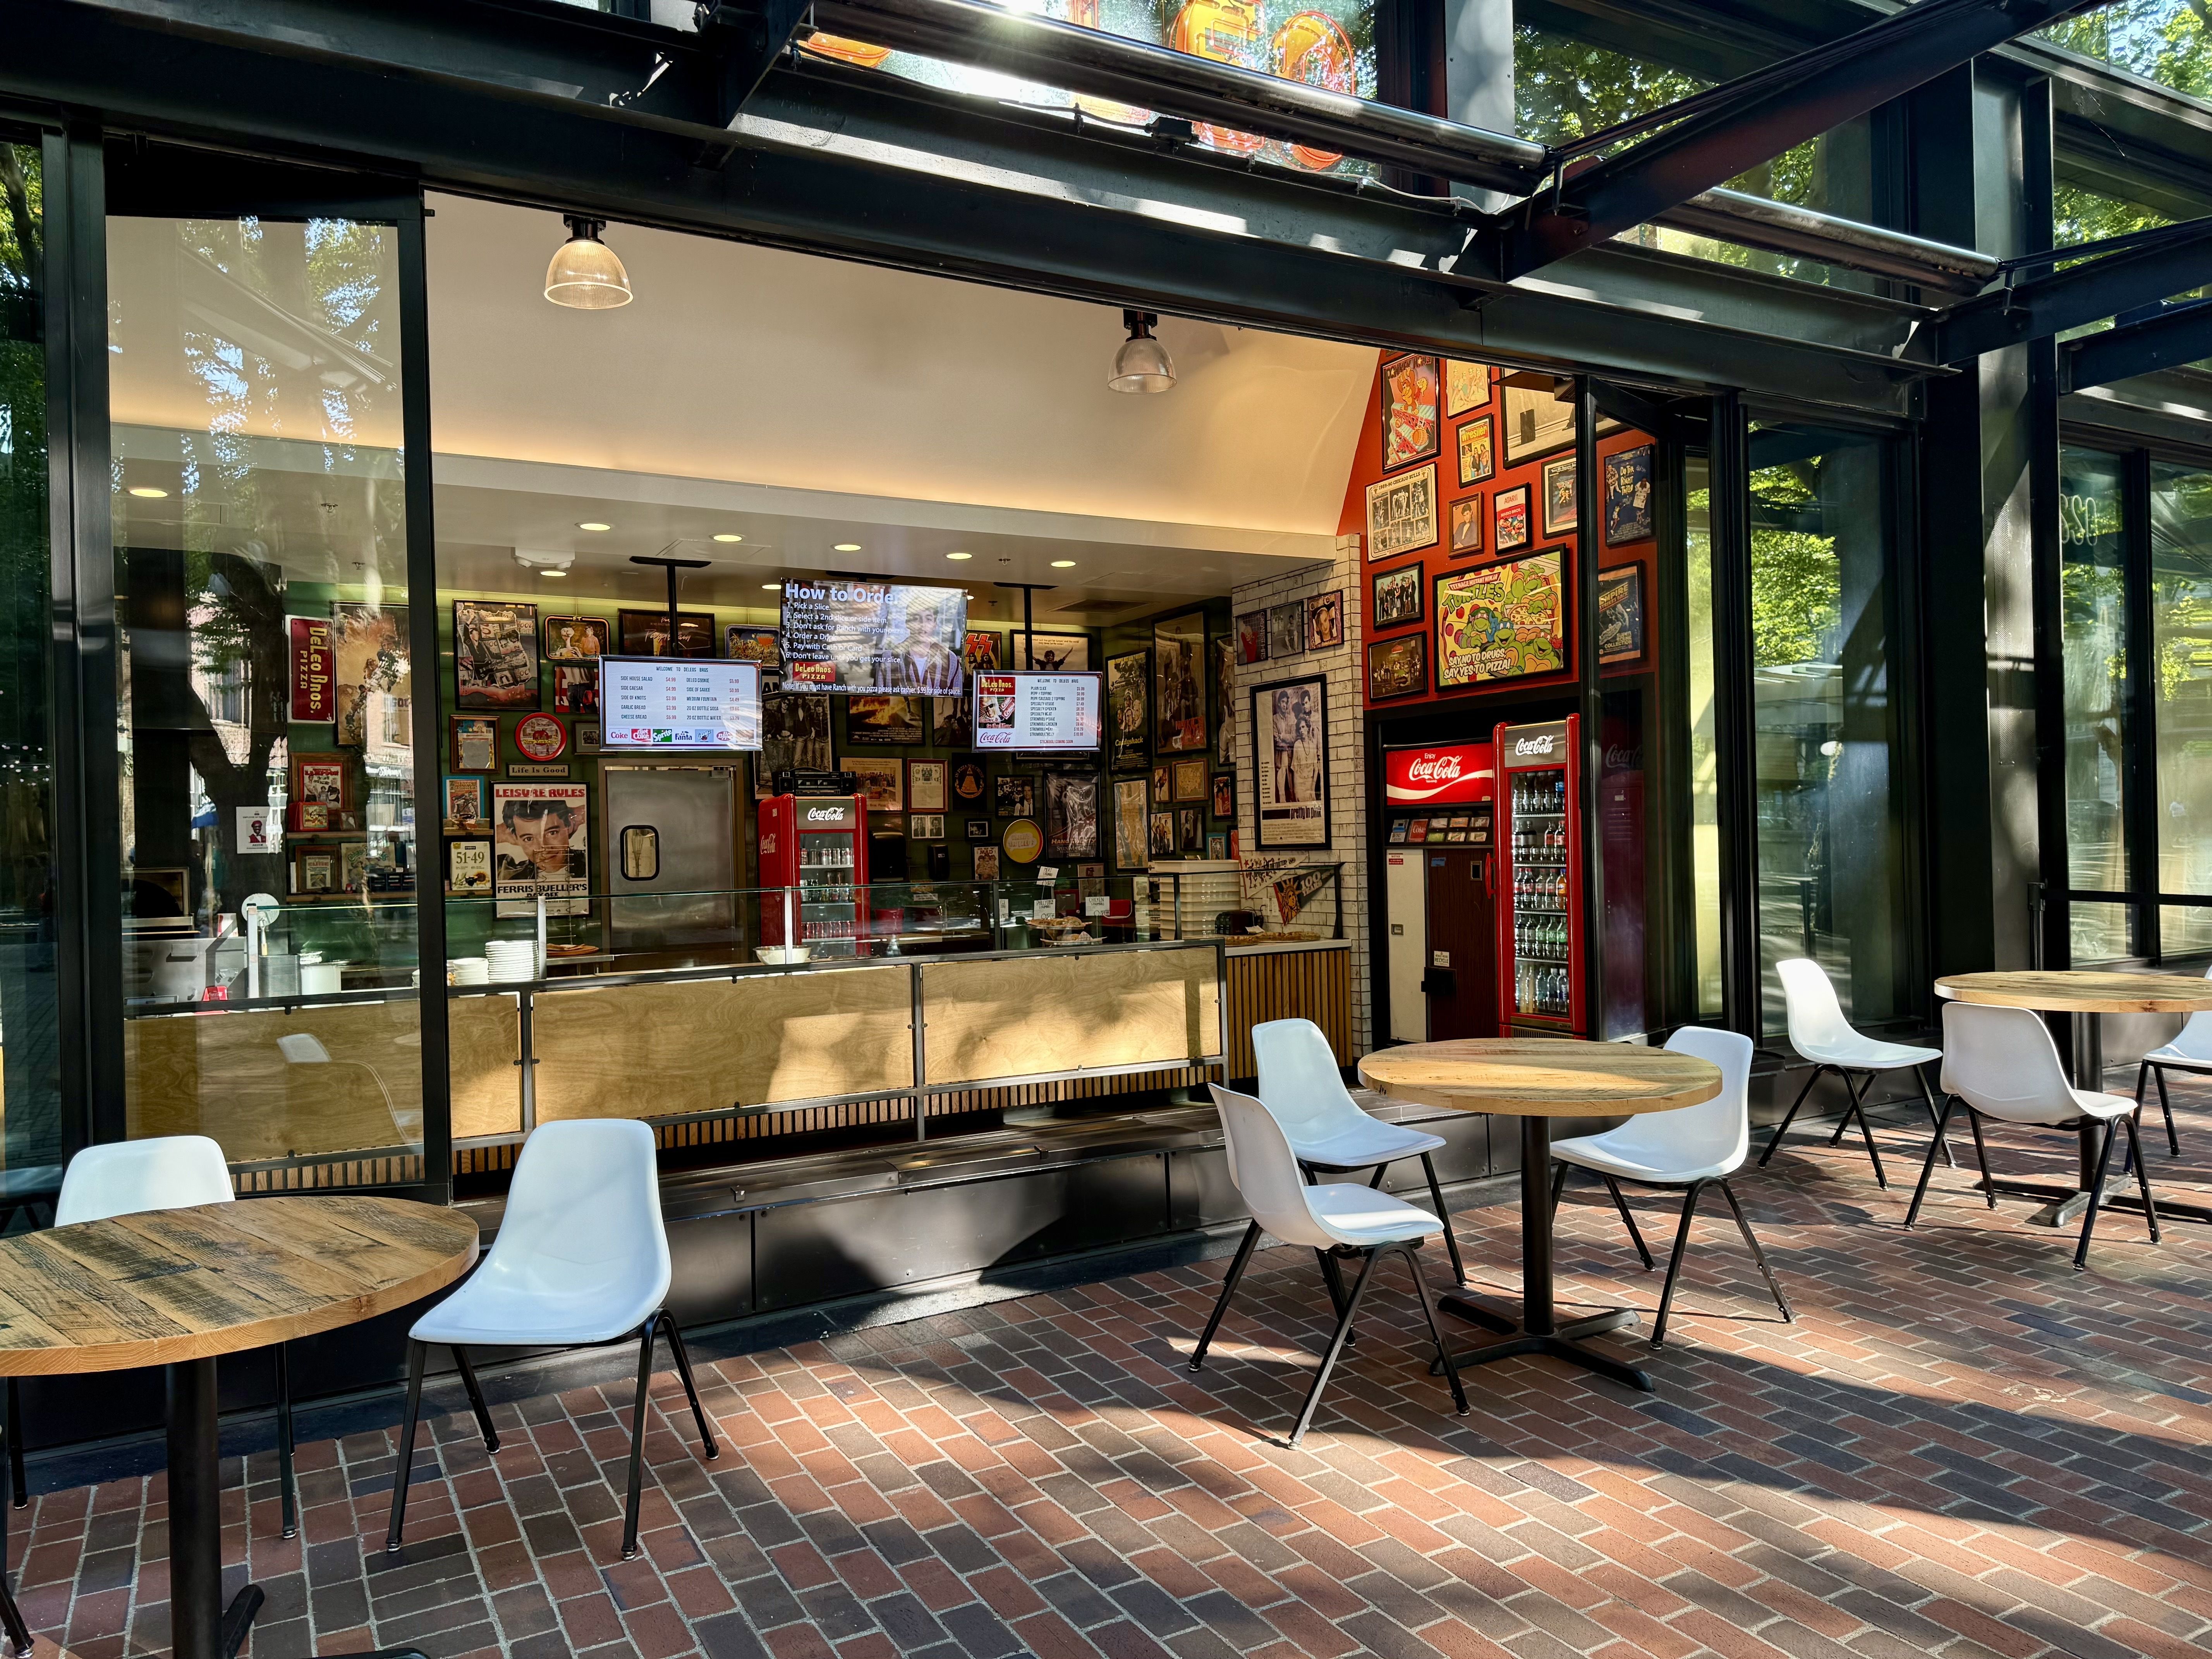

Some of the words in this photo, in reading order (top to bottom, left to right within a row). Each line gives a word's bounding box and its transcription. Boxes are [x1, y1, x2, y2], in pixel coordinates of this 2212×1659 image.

[1393, 476, 1408, 484] CHICAGO
[1451, 580, 1470, 590] TEENAGE
[1470, 576, 1484, 586] MUTANT
[1485, 574, 1498, 582] NINJA
[786, 583, 826, 600] How
[830, 587, 848, 601] to
[853, 587, 899, 604] Order
[1442, 582, 1505, 615] TURTLES
[310, 627, 328, 671] DeLeo
[793, 642, 805, 651] Pay
[1604, 641, 1632, 649] COLLECTION
[1448, 656, 1462, 666] SAY
[1462, 654, 1471, 664] NO
[1472, 653, 1481, 663] TO
[1481, 648, 1506, 661] DRUGS,
[795, 663, 815, 672] DeLeo
[1444, 668, 1459, 679] SAY
[1459, 666, 1474, 677] YES
[1475, 663, 1485, 674] TO
[1486, 658, 1511, 672] PIZZA!
[310, 675, 328, 713] Bros.
[867, 685, 878, 693] pizza
[653, 730, 672, 742] Sprite
[980, 732, 1013, 743] Coca-Cola
[1515, 735, 1554, 756] Coca-Cola
[1409, 756, 1463, 781] Coca-Cola
[495, 788, 548, 798] LEISURE
[548, 788, 585, 798] RULES
[807, 807, 845, 821] Coca-Cola
[1290, 807, 1305, 820] pretty
[1305, 806, 1310, 818] in
[1413, 825, 1426, 833] Coke
[456, 852, 484, 864] 51-49
[1300, 871, 1322, 888] 100
[498, 885, 533, 894] FERRIS
[537, 883, 587, 892] BUELLER'S
